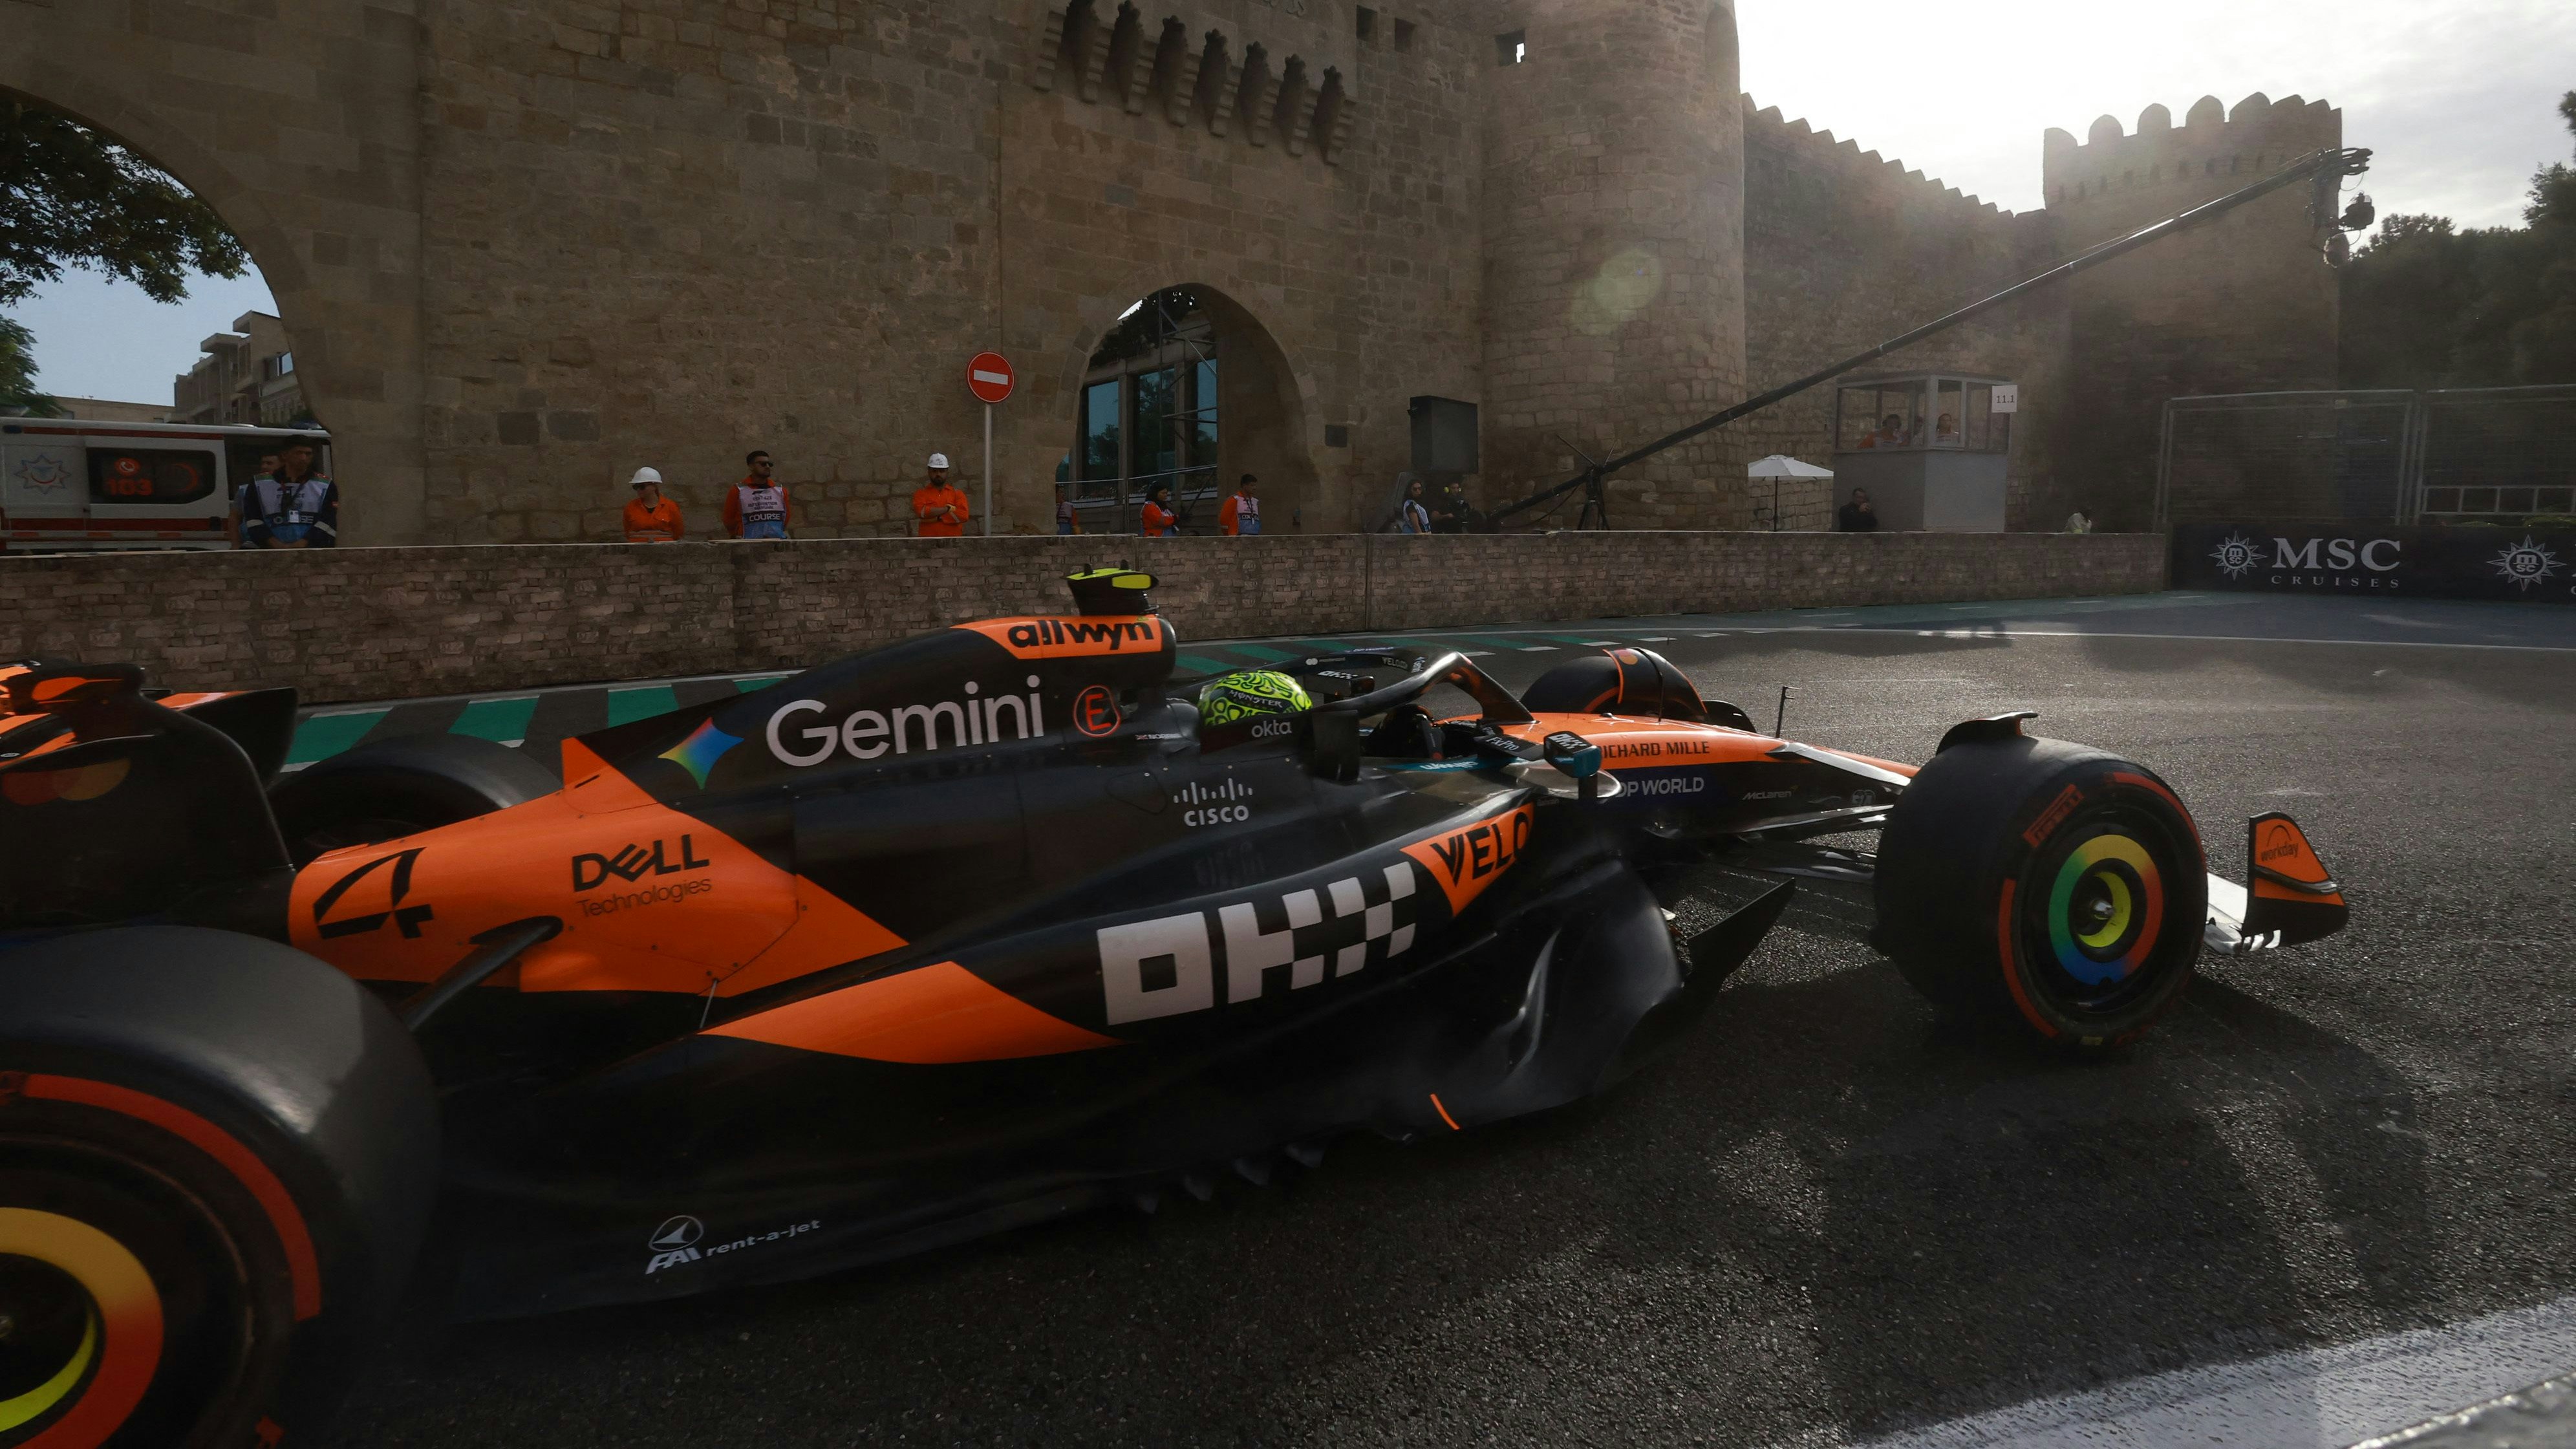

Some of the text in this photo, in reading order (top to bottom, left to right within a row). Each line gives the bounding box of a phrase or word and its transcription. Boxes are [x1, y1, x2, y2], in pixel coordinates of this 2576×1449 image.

[1997, 394, 2014, 403] 11.1
[105, 477, 154, 497] 103
[749, 513, 780, 522] COURSE
[2273, 537, 2401, 571] MSC
[2271, 575, 2399, 588] CRUISES
[1007, 617, 1155, 650] allwyn
[766, 675, 1044, 767] Gemini
[1086, 693, 1111, 732] E
[1252, 719, 1293, 738] okta
[1486, 736, 1519, 751] FxPro
[1599, 741, 1710, 759] ICHARD MILLE
[1642, 777, 1704, 796] WORLD
[1742, 790, 1792, 800] McLaren
[1430, 812, 1529, 887] VELO
[2261, 841, 2299, 861] workday
[572, 834, 710, 892] DELL
[313, 847, 433, 939] 4
[577, 877, 712, 918] Technologies
[1097, 861, 1416, 1025] OKX
[645, 1219, 821, 1274] FAI rent-a-jet
